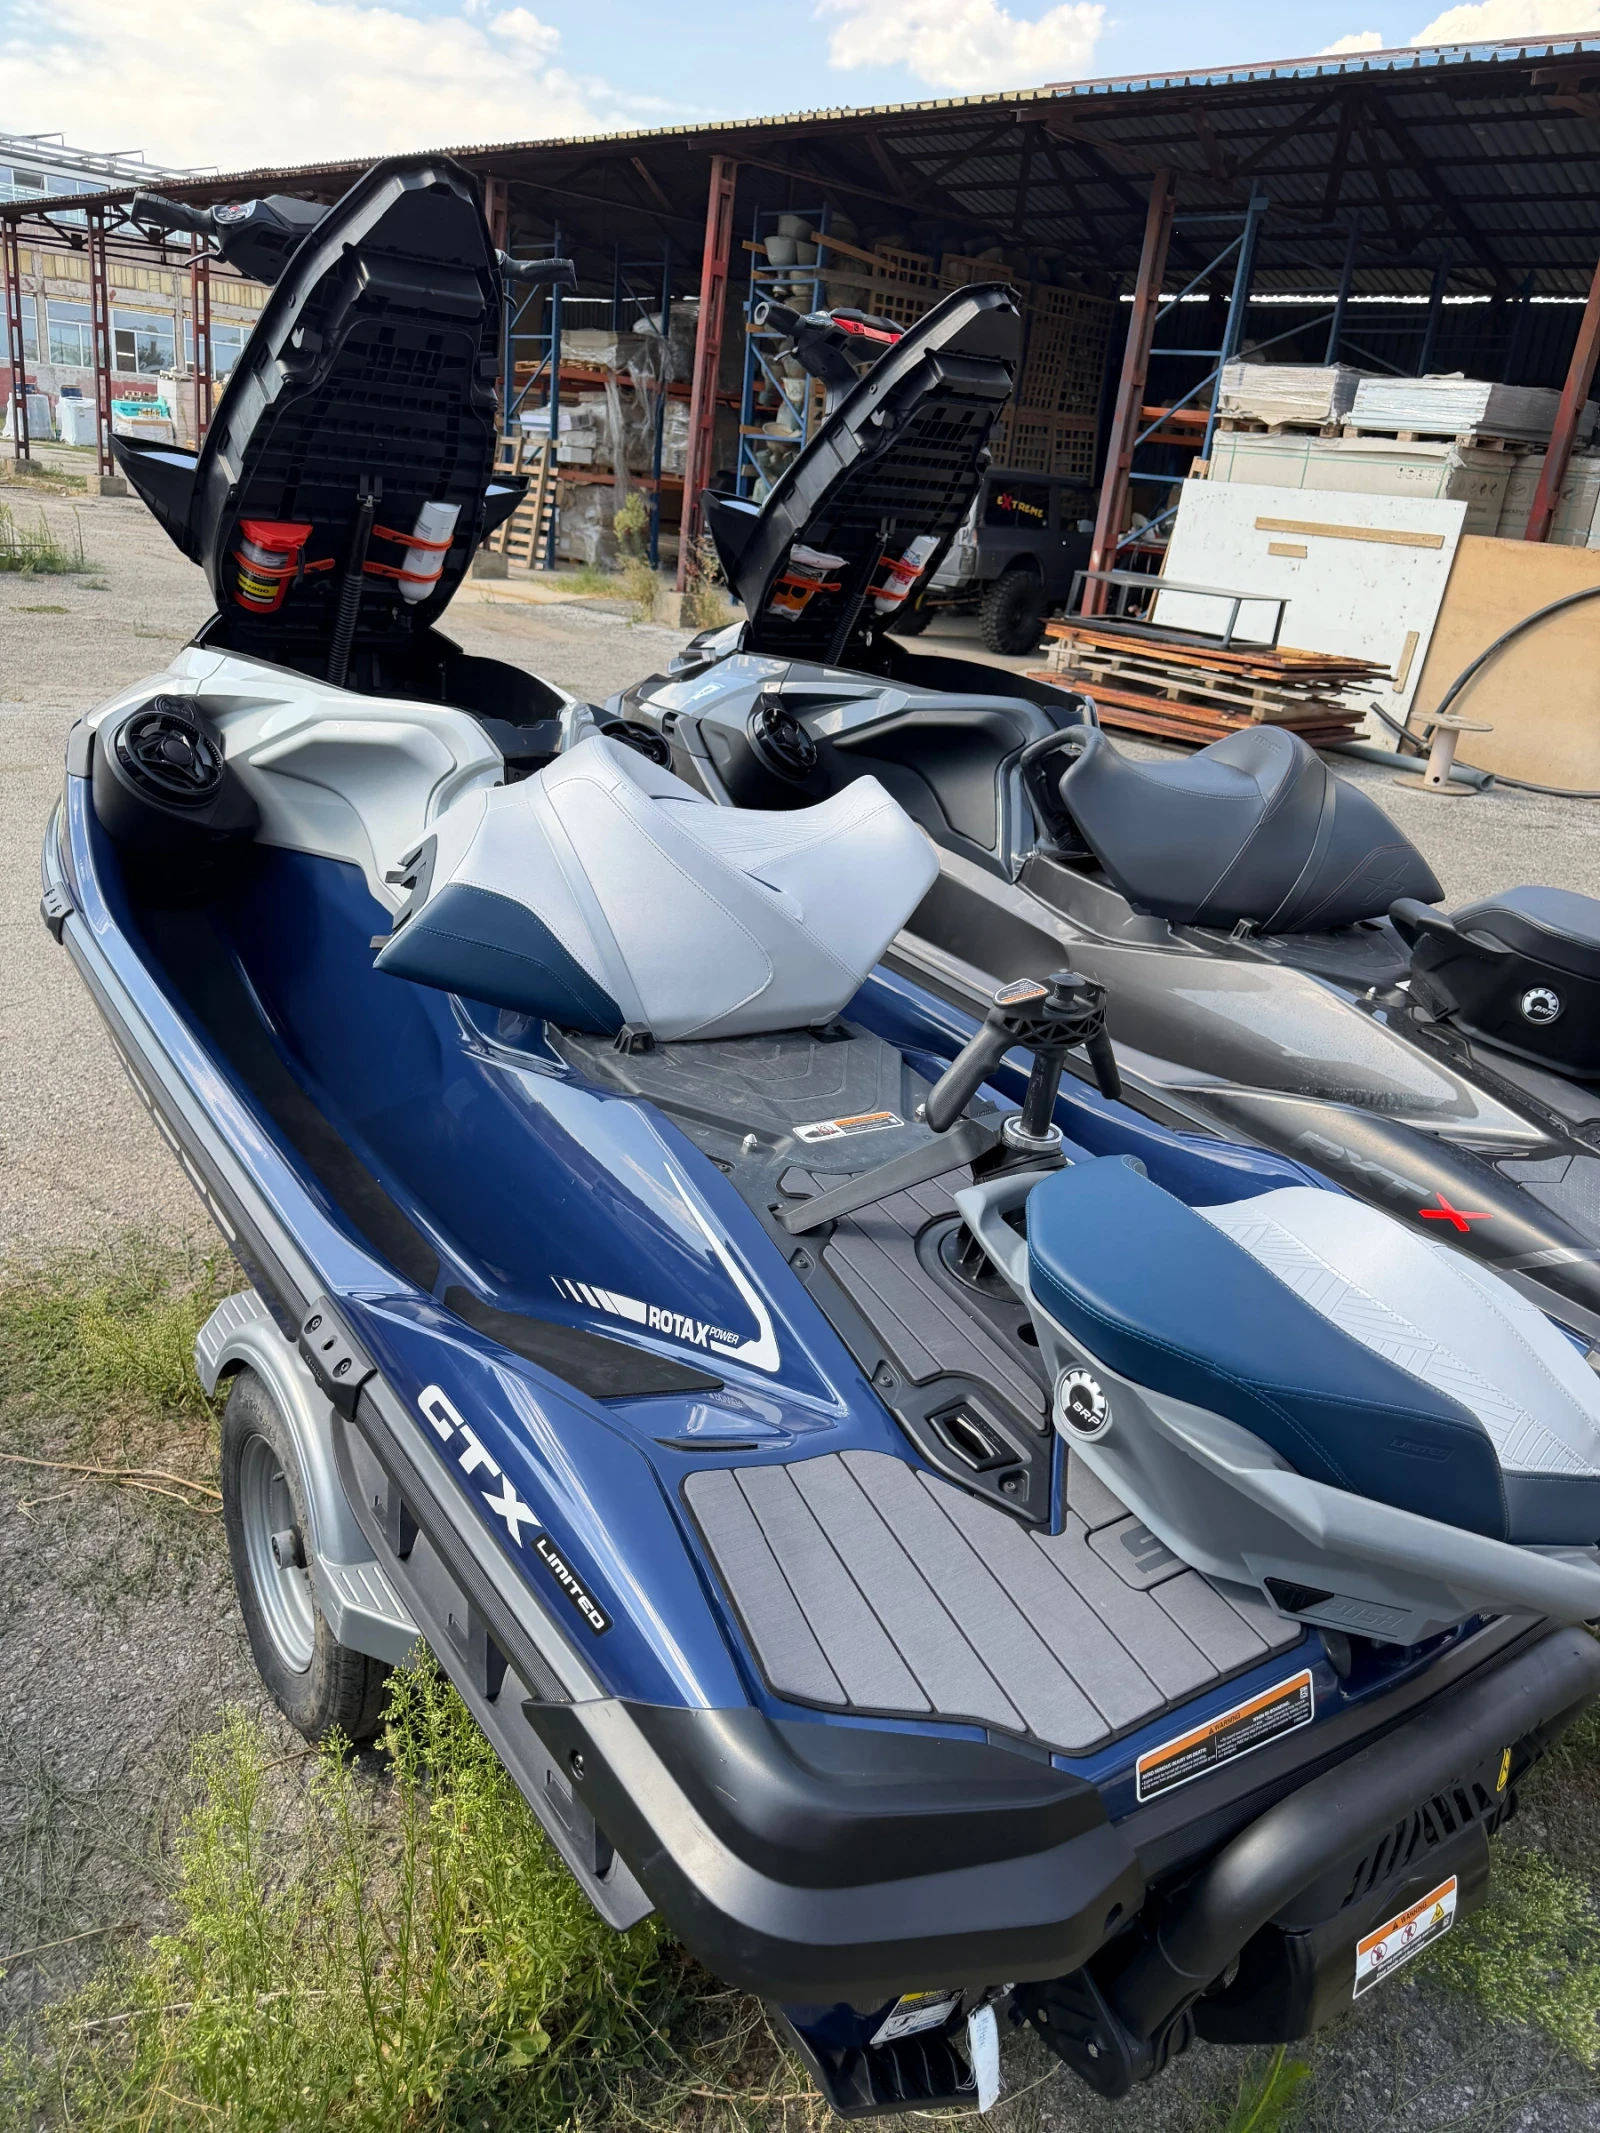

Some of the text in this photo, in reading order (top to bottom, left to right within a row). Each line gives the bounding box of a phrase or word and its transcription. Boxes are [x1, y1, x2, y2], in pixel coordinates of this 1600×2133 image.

[1533, 1005, 1554, 1015] BRP
[648, 1305, 740, 1348] ROTAX POWER
[1072, 1401, 1101, 1425] BRP
[417, 1384, 606, 1630] GTX LIMITED
[1319, 1602, 1404, 1629] PUSH
[1214, 1712, 1241, 1732] WARNING
[1400, 1901, 1427, 1924] WARNING
